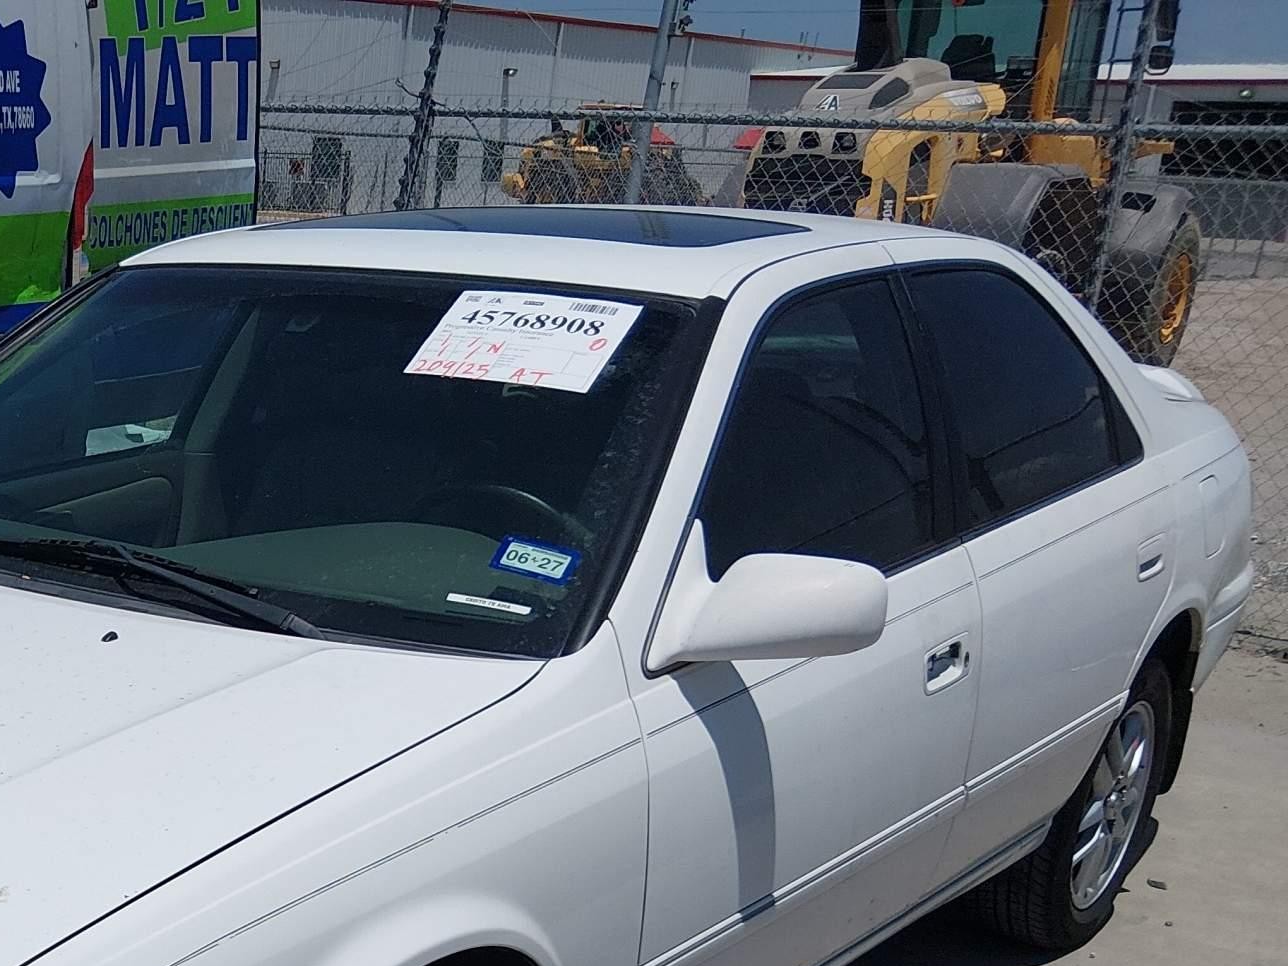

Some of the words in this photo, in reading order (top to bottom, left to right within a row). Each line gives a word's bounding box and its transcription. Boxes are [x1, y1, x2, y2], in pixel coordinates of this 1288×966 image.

[6, 70, 21, 93] AVE
[98, 34, 257, 149] MATT
[88, 210, 168, 249] COLCHONES
[171, 207, 188, 240] DE
[462, 308, 606, 337] 45768908
[506, 549, 531, 565] 06
[537, 557, 565, 572] 27
